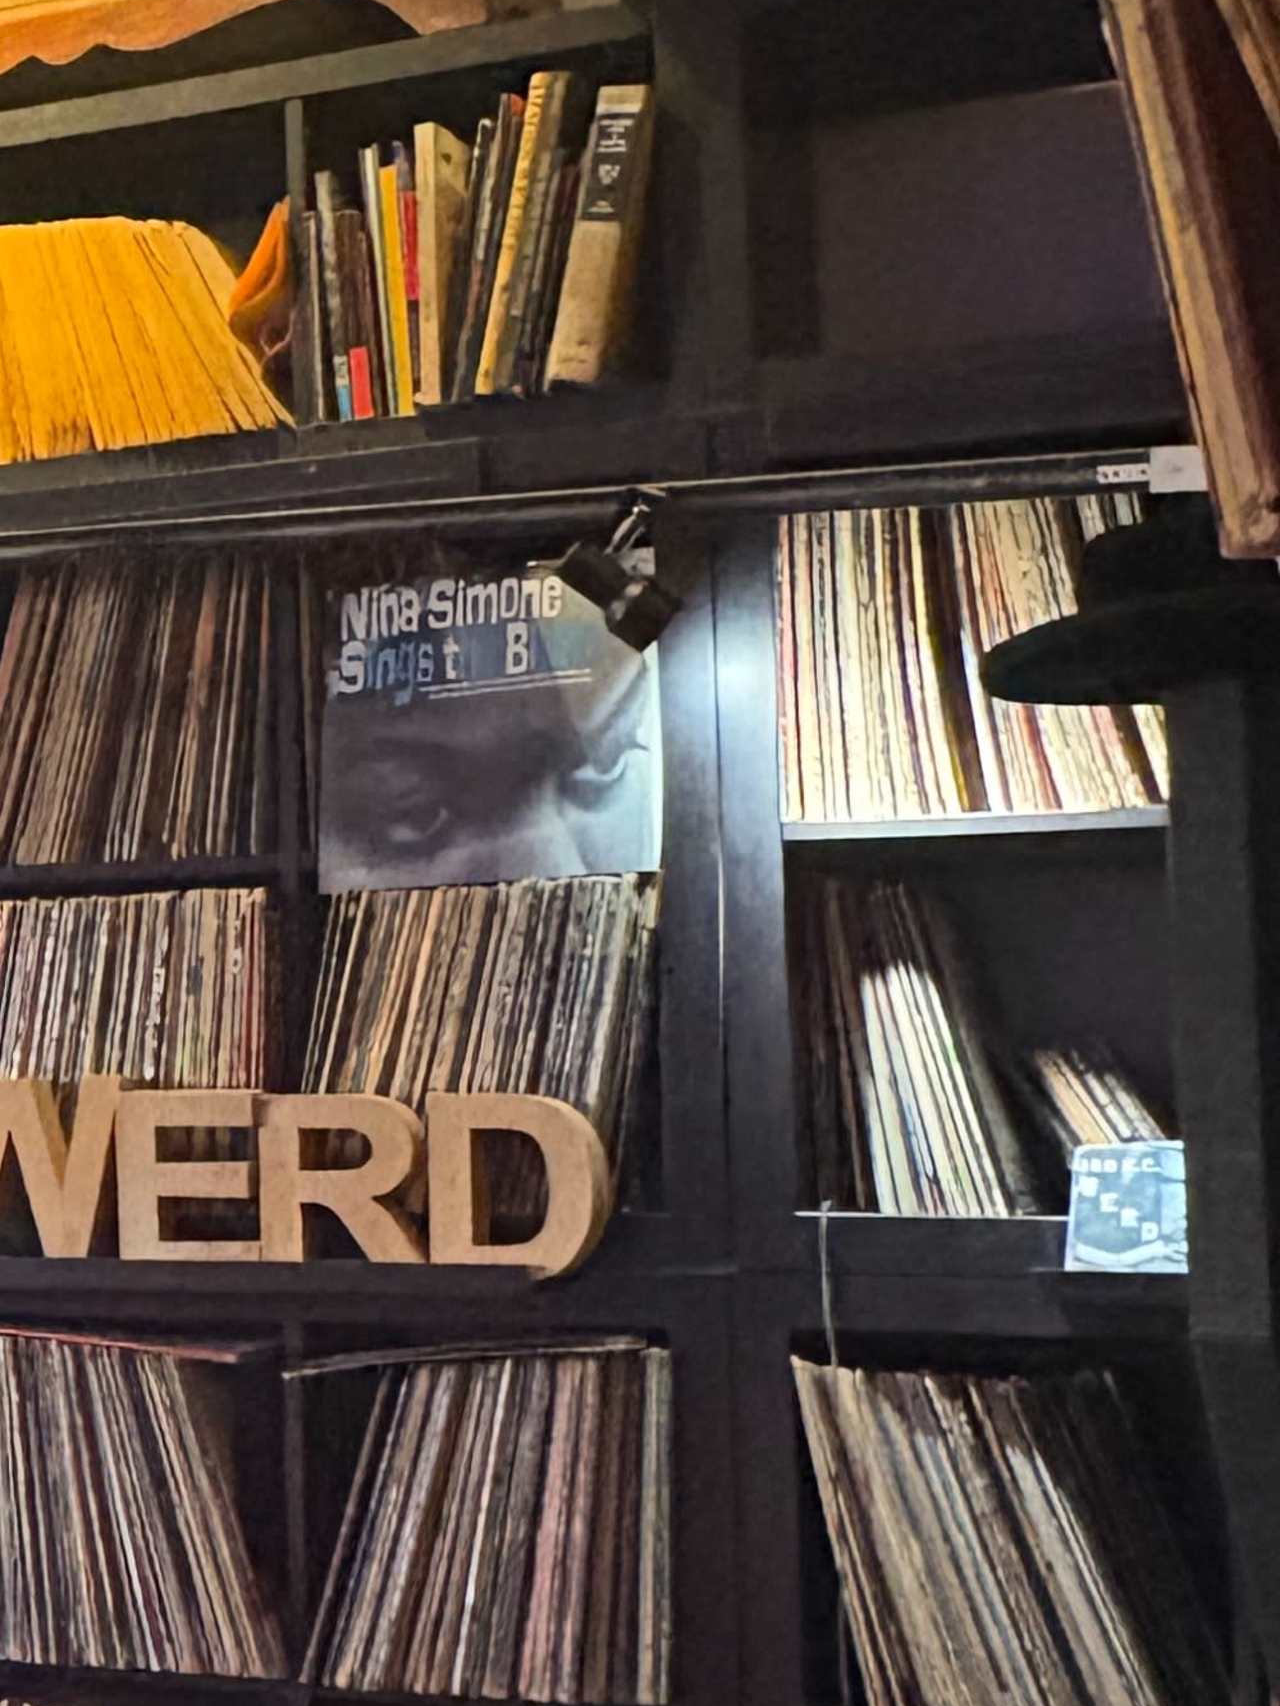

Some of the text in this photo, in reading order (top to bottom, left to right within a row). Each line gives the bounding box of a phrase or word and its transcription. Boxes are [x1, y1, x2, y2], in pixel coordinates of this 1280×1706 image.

[340, 575, 562, 642] Nina Simone
[336, 640, 435, 706] Sings
